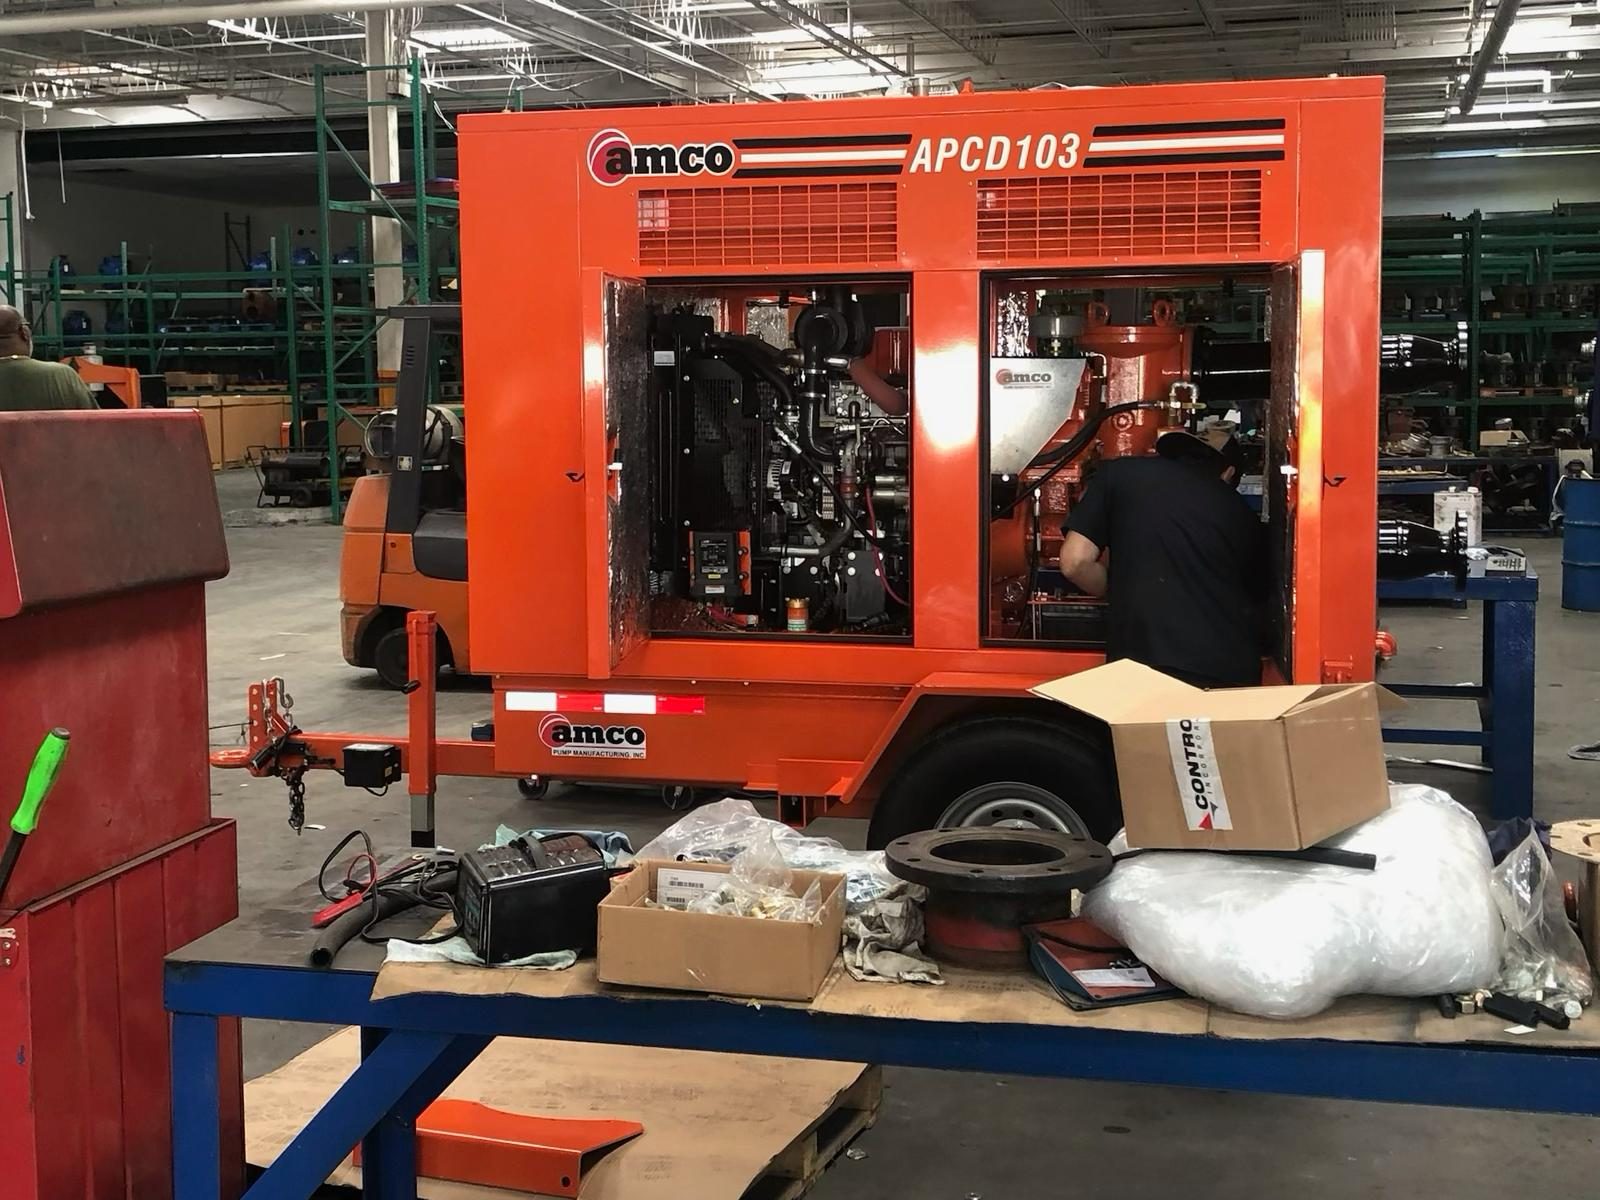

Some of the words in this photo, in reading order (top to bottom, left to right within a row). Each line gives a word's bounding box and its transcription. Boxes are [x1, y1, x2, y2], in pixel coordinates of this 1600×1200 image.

[605, 145, 733, 175] amco
[909, 132, 1081, 173] APCD103
[1003, 372, 1052, 383] amco
[551, 725, 645, 746] amco
[1179, 719, 1209, 810] CONTRO
